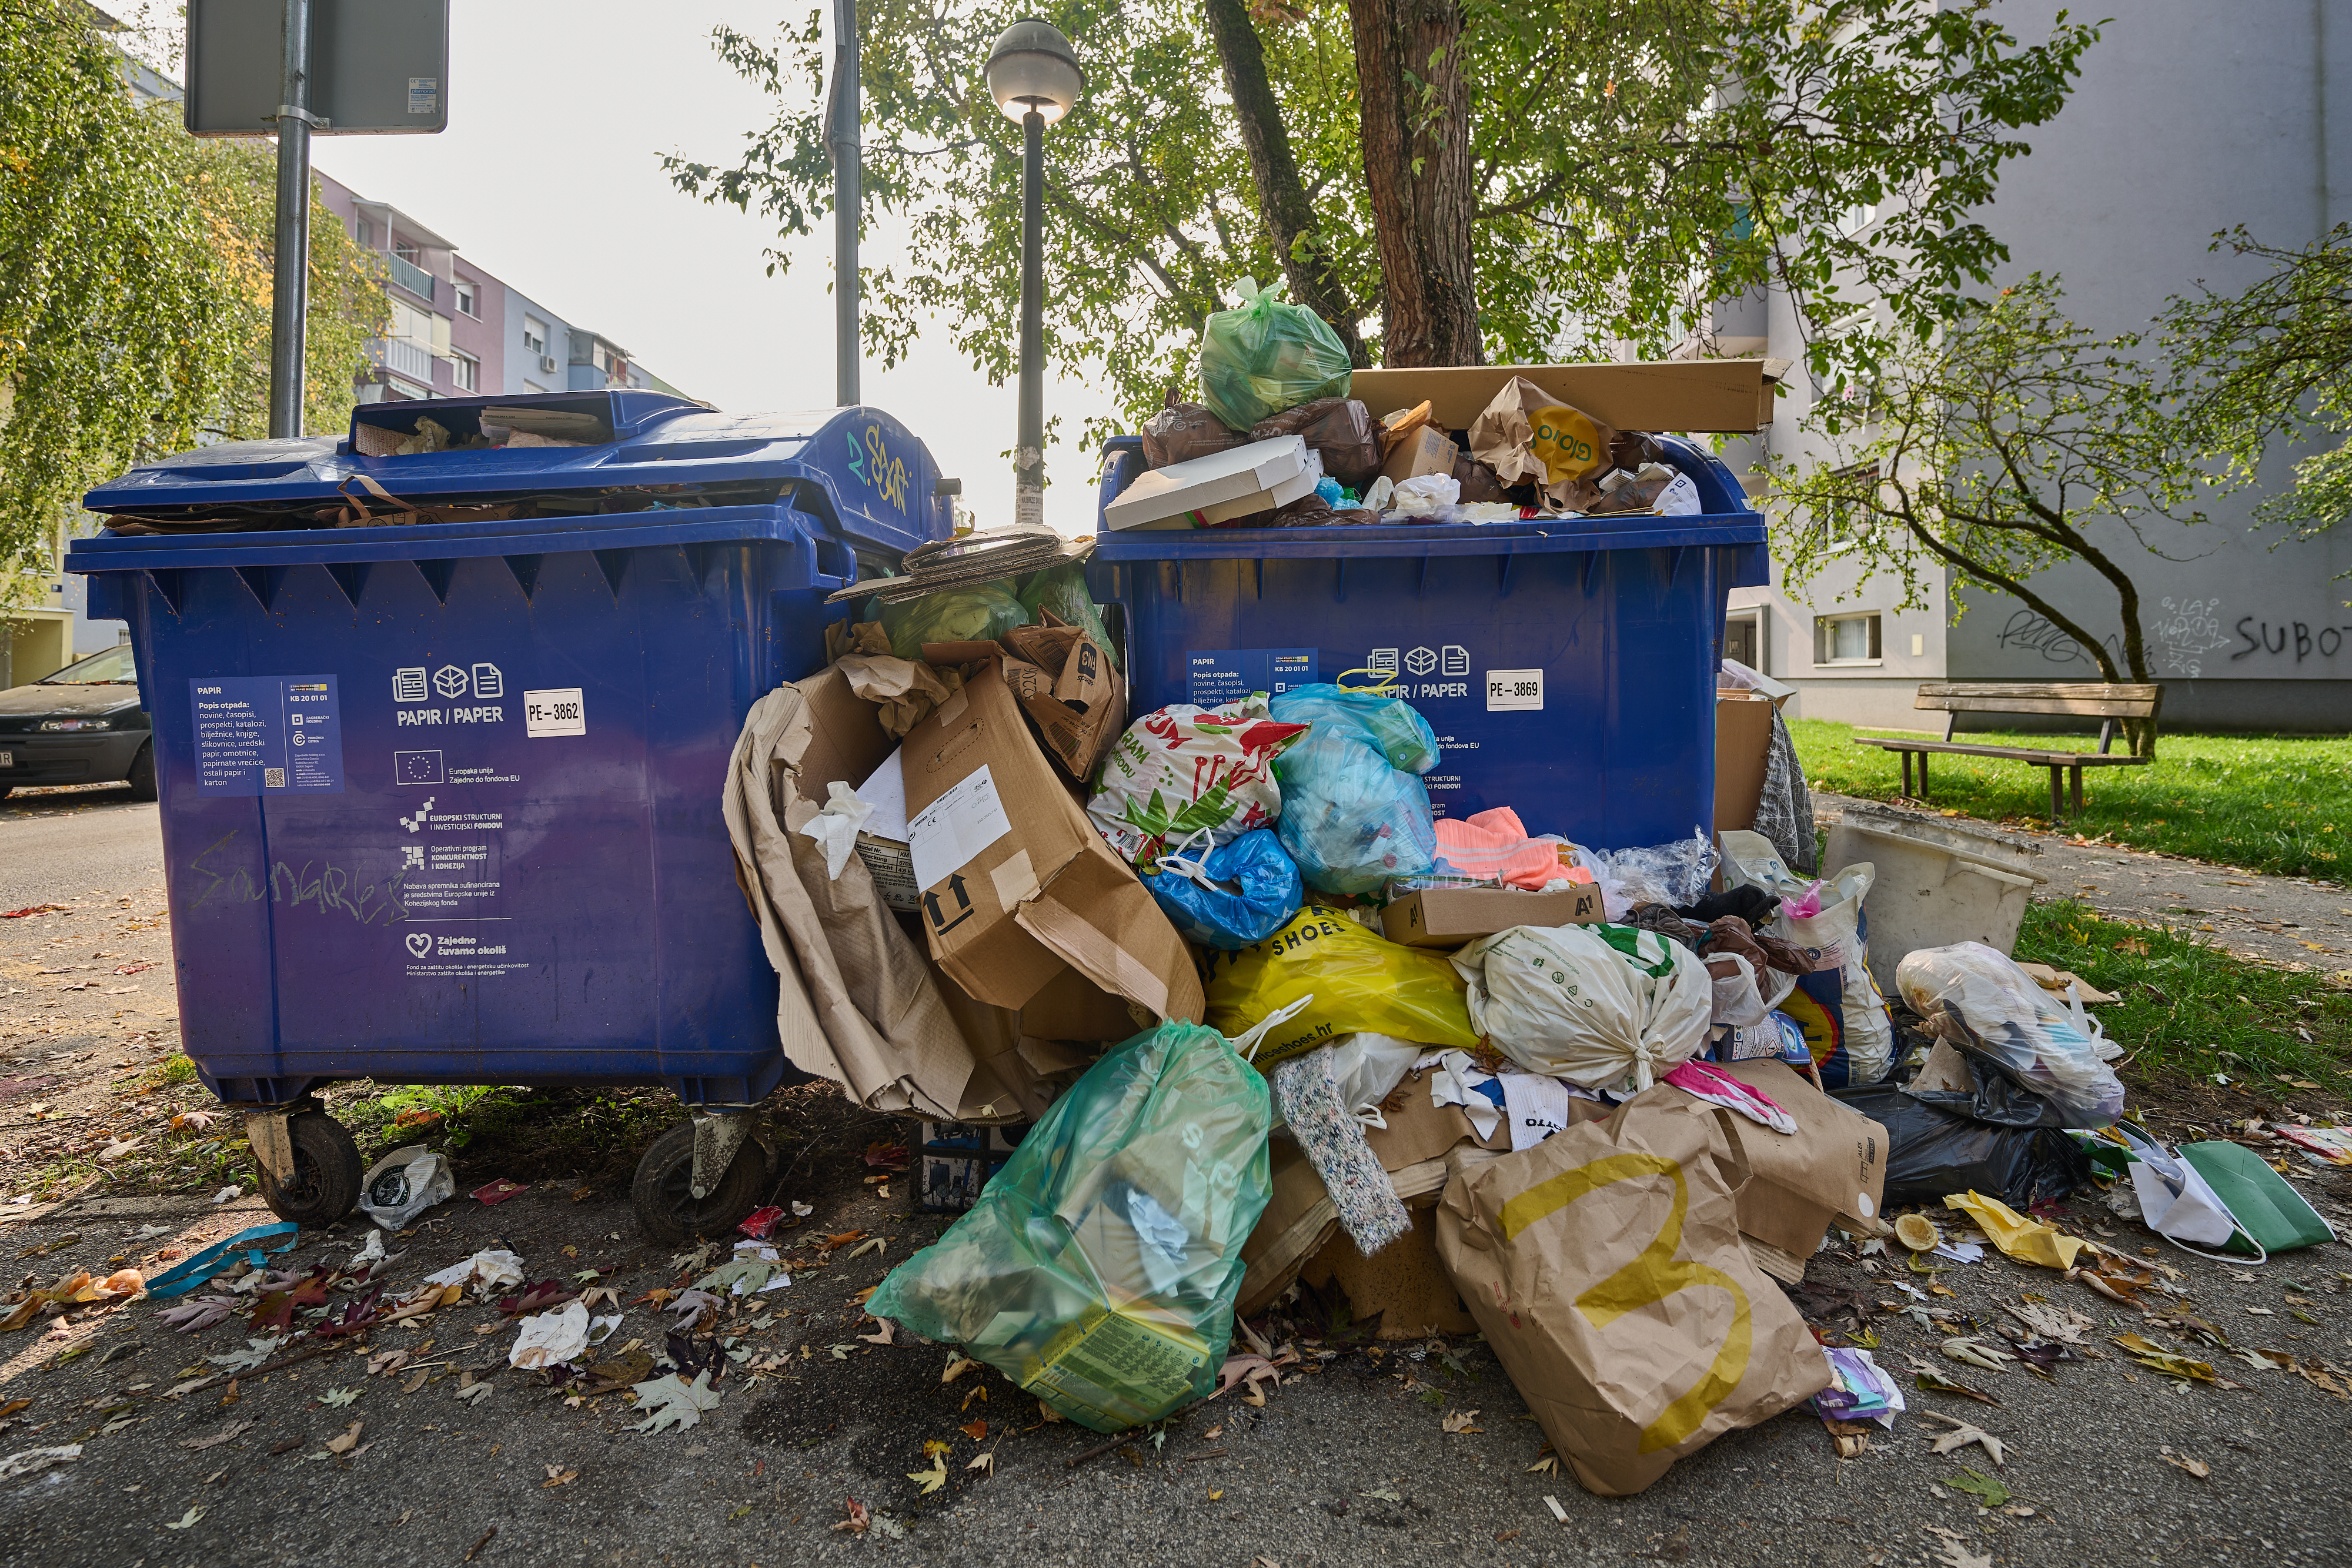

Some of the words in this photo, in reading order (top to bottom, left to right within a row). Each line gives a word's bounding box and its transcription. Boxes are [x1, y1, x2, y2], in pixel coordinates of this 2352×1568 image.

[1413, 684, 1417, 698] /
[1421, 683, 1467, 698] PAPER
[199, 702, 219, 710] Popis
[220, 701, 250, 710] otpada:
[226, 710, 256, 719] časopisi,
[397, 708, 442, 726] PAPIR
[445, 708, 450, 724] /
[454, 706, 504, 724] PAPER
[201, 721, 235, 730] prospekti,
[201, 731, 235, 739] bilježnice,
[236, 730, 260, 738] knjige,
[202, 751, 222, 759] papir,
[203, 760, 236, 768] papirnate
[224, 769, 242, 777] papir
[449, 767, 477, 775] Europska
[479, 767, 494, 775] unija
[449, 776, 474, 784] Zajedno
[430, 814, 462, 823] EUROPSKI
[463, 813, 503, 821] STRUKTURNI
[977, 808, 998, 824] 320.0521.741
[434, 823, 473, 831] INVESTICIJSKI
[463, 845, 487, 854] program
[1575, 894, 1593, 917] A1
[1411, 904, 1418, 928] A1
[437, 937, 477, 946] Zajedno
[437, 947, 476, 955] čuvamo
[477, 945, 506, 955] okoliš
[1542, 944, 1562, 961] plastičnog
[1561, 958, 1580, 975] materijala
